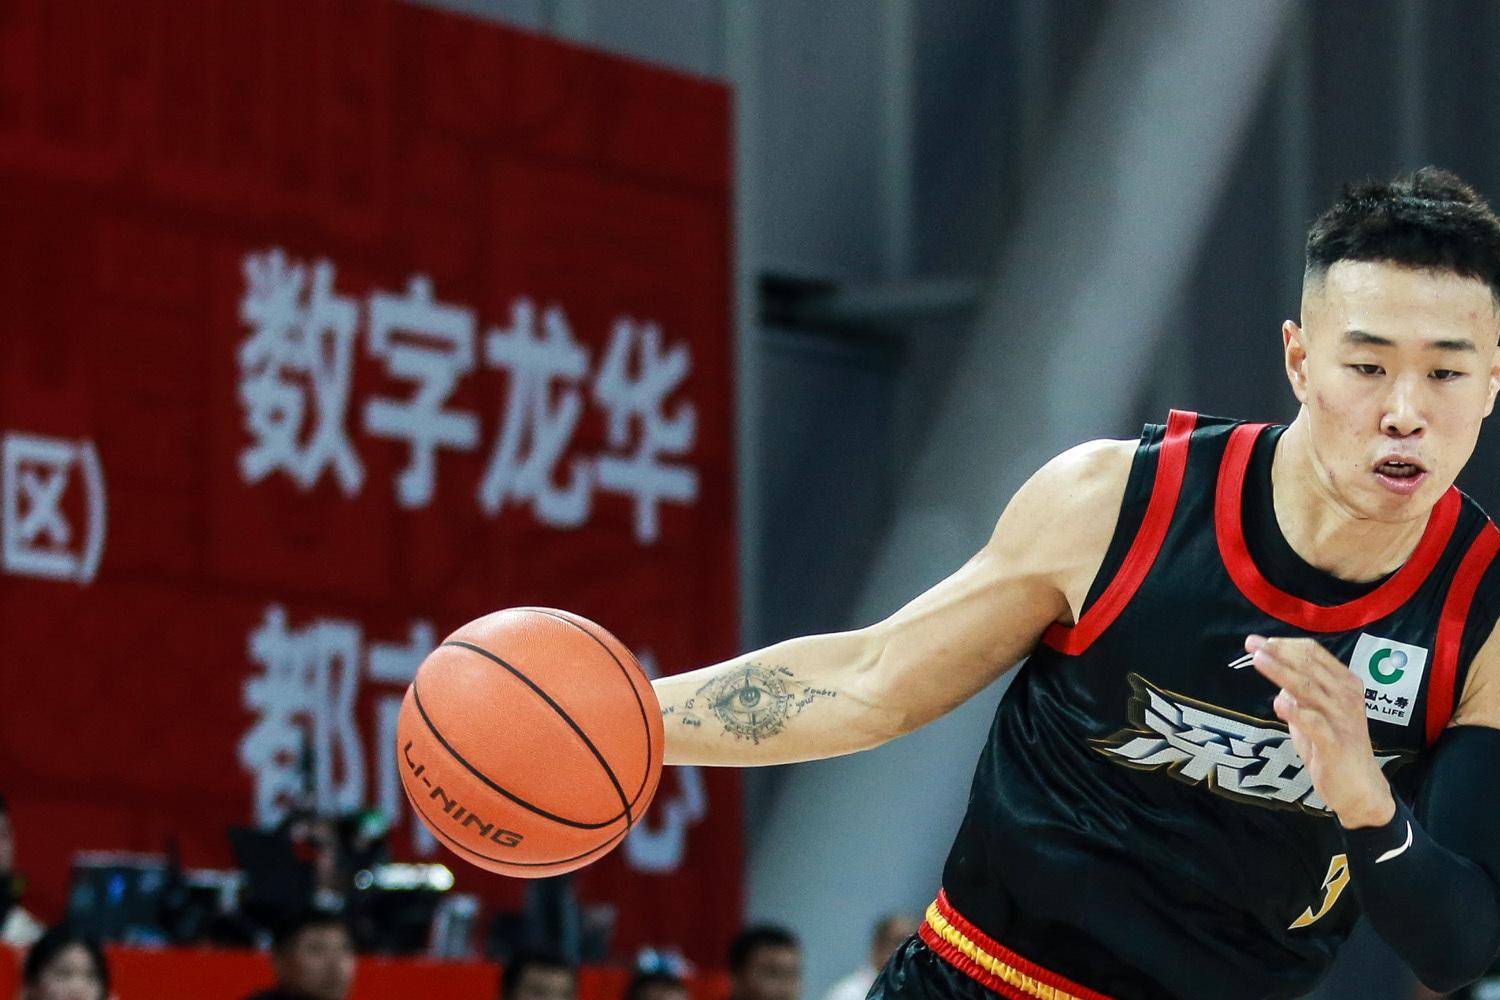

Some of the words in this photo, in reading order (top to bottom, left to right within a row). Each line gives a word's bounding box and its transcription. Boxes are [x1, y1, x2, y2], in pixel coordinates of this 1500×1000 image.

[240, 250, 698, 544] 数字龙华
[1382, 707, 1405, 718] LIFE
[402, 741, 524, 848] LI-NING
